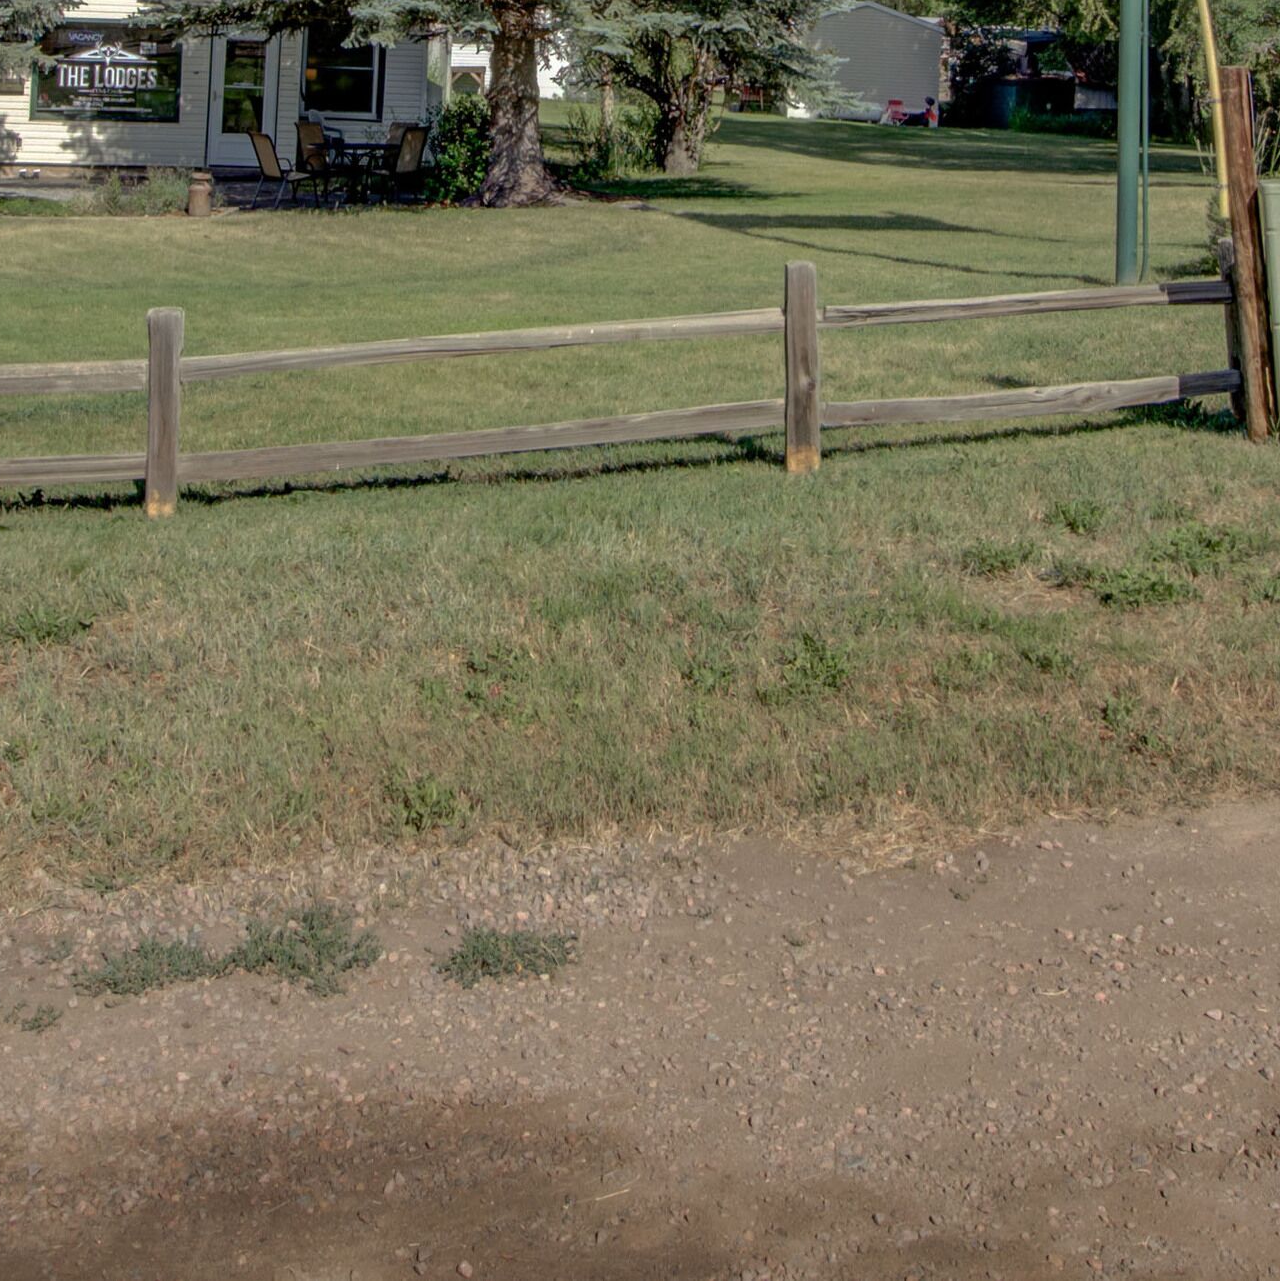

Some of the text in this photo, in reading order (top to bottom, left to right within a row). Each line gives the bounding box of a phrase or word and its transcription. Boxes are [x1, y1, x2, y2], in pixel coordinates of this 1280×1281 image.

[68, 32, 104, 42] VACANCY
[58, 65, 158, 89] THE LODGES
